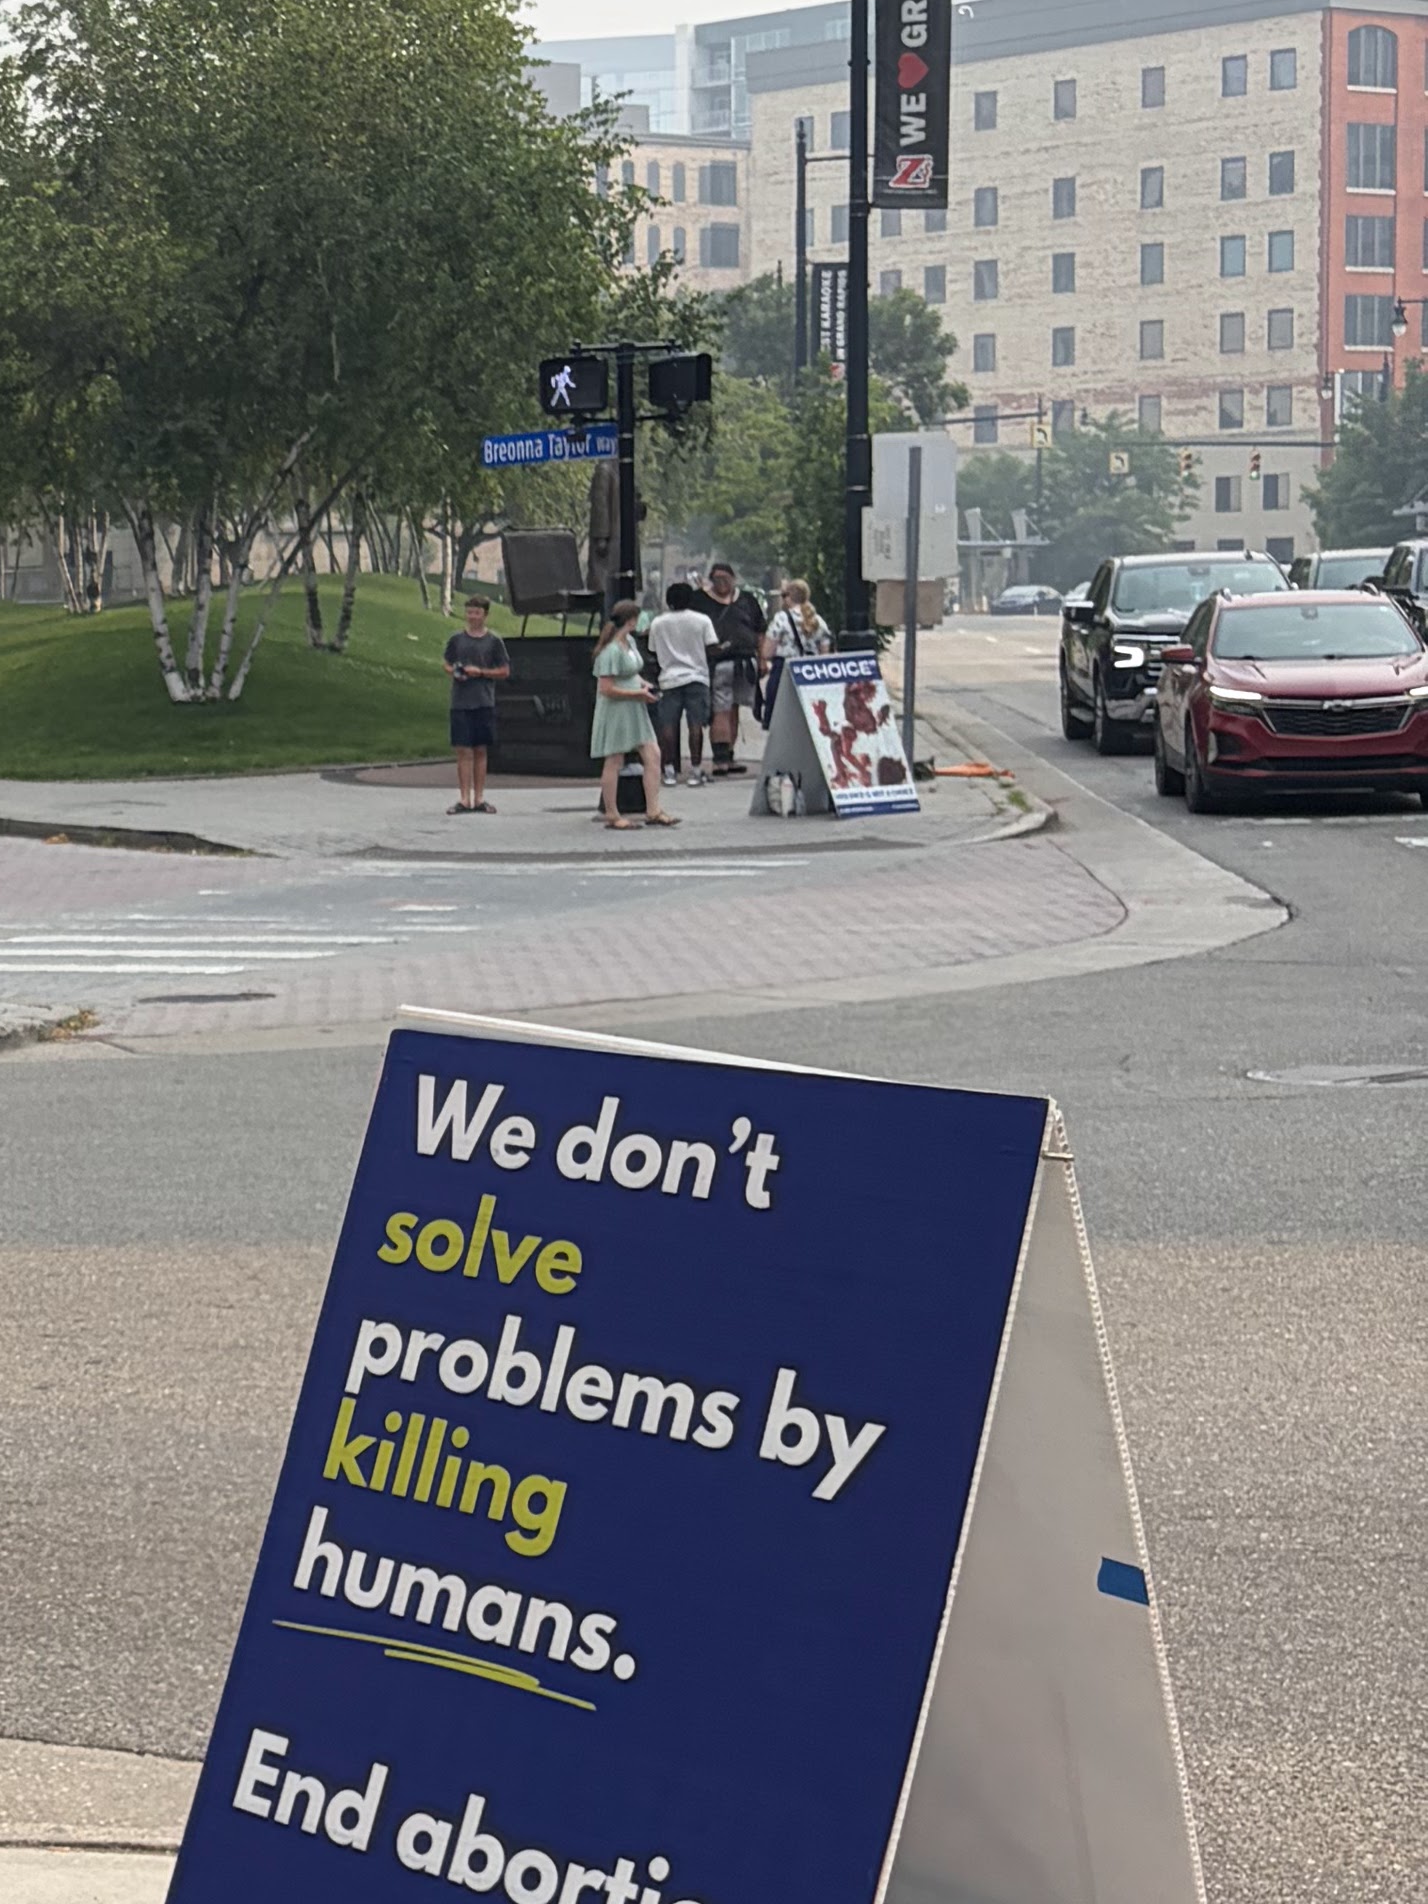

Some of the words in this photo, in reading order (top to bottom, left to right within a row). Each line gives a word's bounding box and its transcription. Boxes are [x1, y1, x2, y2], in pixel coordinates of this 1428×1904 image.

[899, 91, 926, 146] WE
[820, 270, 832, 329] KARAOKE
[484, 437, 543, 464] Breonna
[414, 1075, 537, 1172] We
[555, 1096, 781, 1210] don't
[378, 1195, 583, 1295] solve
[345, 1316, 740, 1451] problems
[760, 1369, 885, 1502] by
[323, 1399, 568, 1558] killing
[293, 1506, 639, 1683] humans.
[232, 1728, 389, 1853] End
